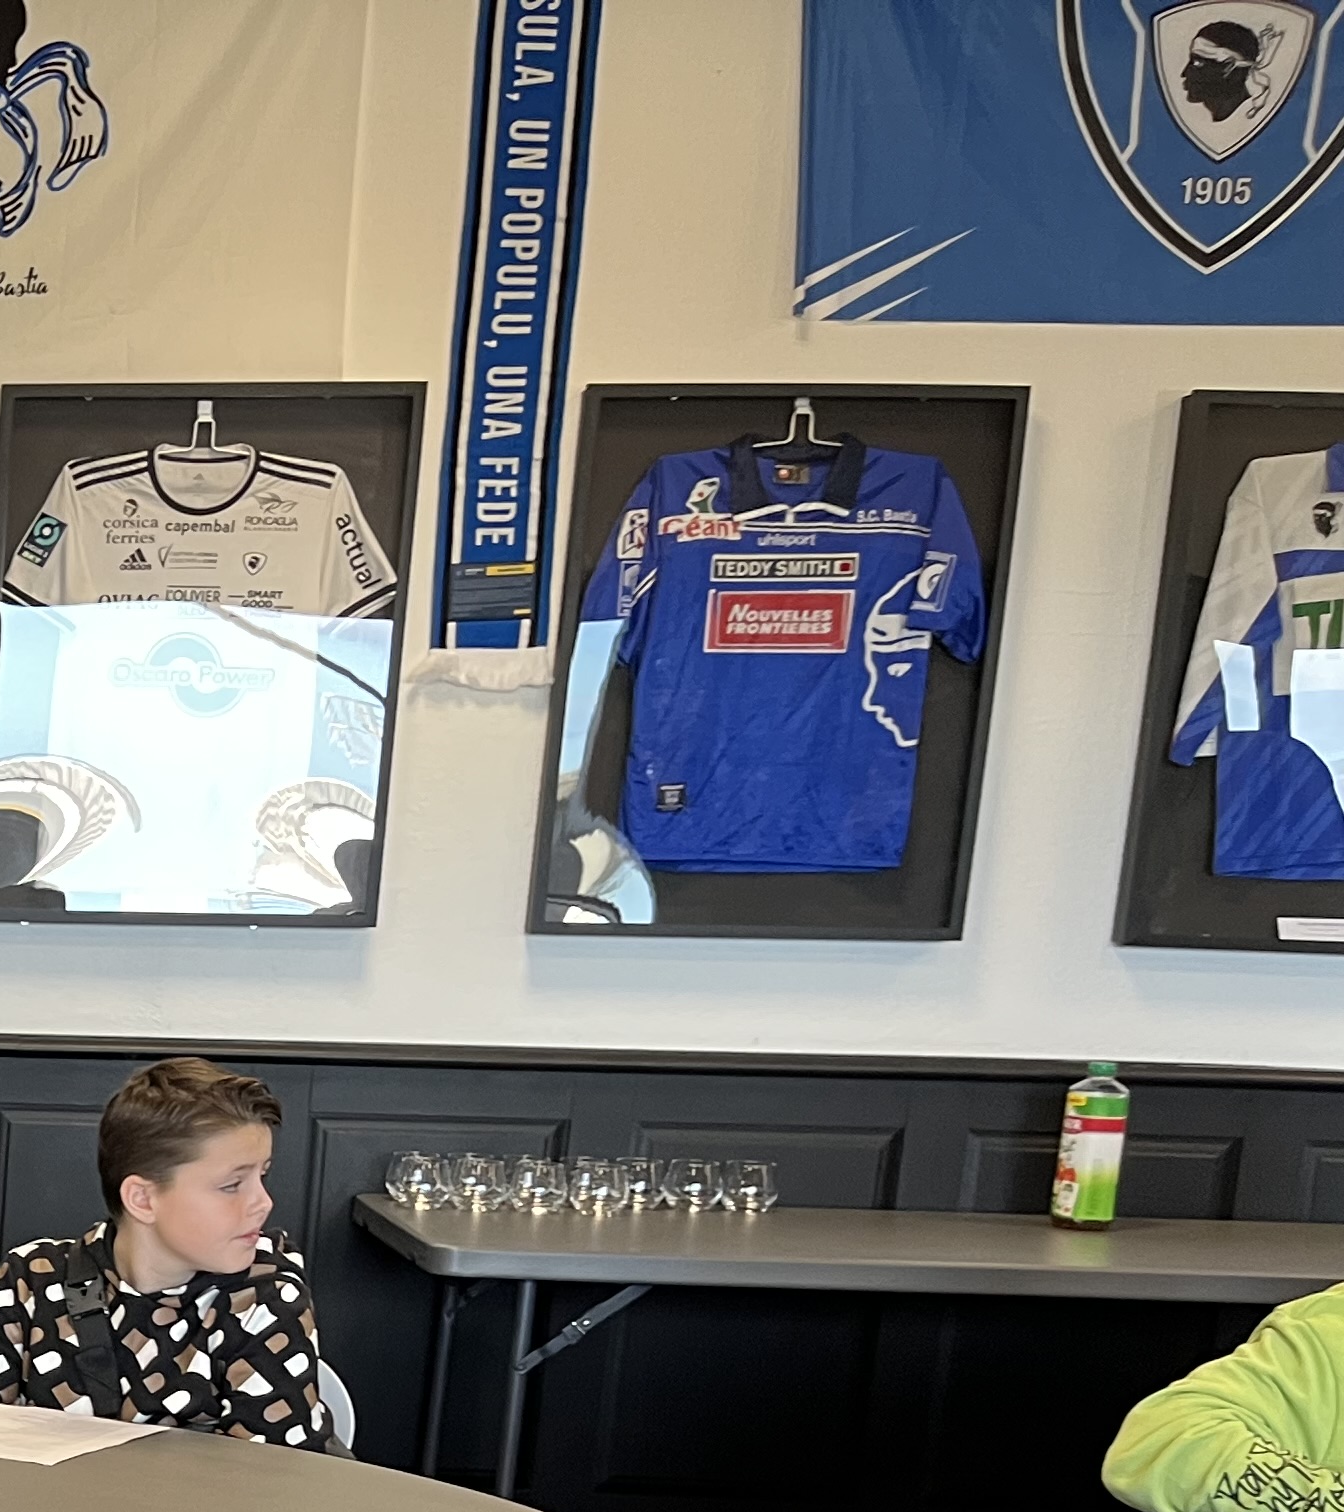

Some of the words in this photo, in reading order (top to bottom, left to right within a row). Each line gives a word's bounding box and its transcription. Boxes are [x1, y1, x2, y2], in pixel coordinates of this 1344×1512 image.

[506, 119, 551, 170] UN
[1181, 177, 1252, 205] 1905
[483, 187, 545, 348] POPULU,
[480, 365, 528, 440] UNA
[474, 456, 520, 546] FEDE
[103, 515, 159, 529] corsica
[165, 519, 235, 535] capembal
[105, 530, 156, 544] ferries
[336, 513, 383, 590] actual
[716, 560, 774, 576] TEDDY
[775, 560, 831, 576] SMITH
[241, 600, 273, 608] GOOD
[247, 590, 283, 599] SMART
